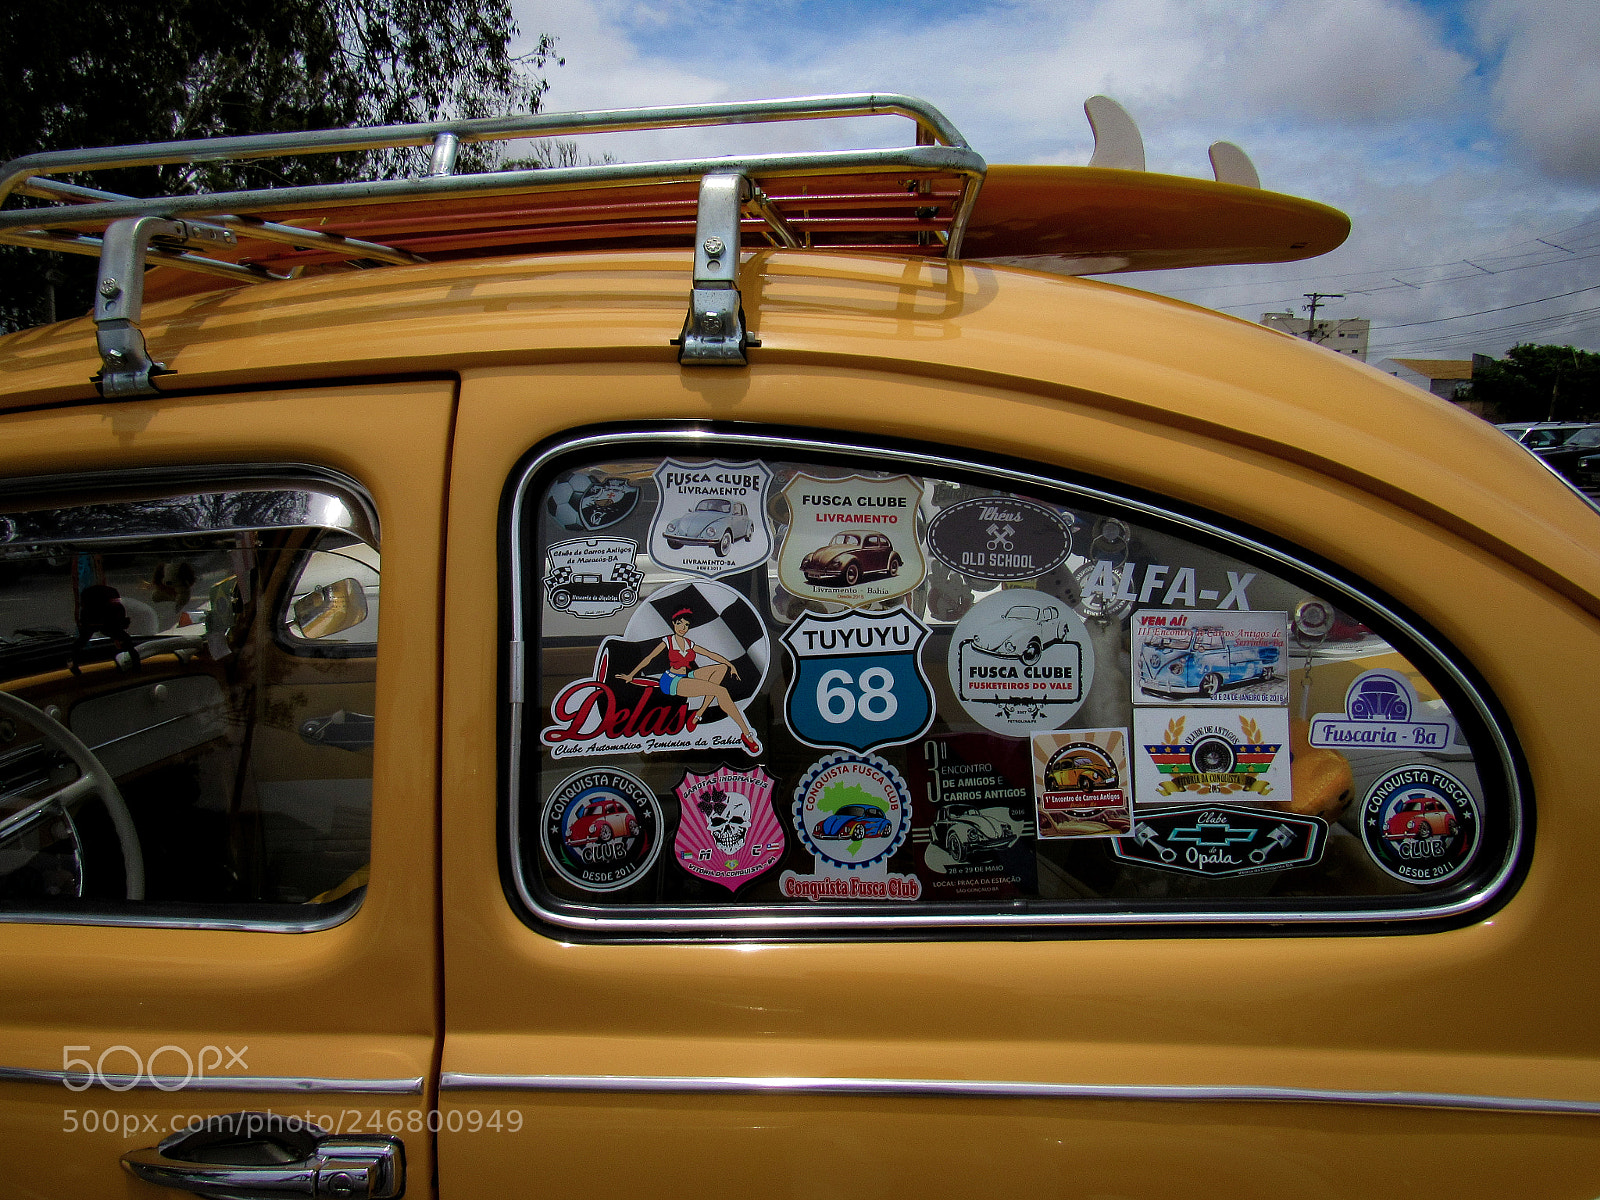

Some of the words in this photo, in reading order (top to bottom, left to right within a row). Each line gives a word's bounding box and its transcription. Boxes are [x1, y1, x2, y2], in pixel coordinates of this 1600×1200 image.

[666, 472, 712, 489] FUSCA
[715, 473, 760, 492] CLUBE
[678, 486, 747, 496] LIVRAMENTO
[802, 494, 853, 506] FUSCA
[857, 496, 907, 508] CLUBE
[816, 513, 898, 524] LIVRAMENTO
[962, 551, 985, 566] OLD
[989, 553, 1036, 569] SCHOOL
[812, 585, 858, 594] Livramento
[867, 587, 889, 595] Bahia
[1080, 560, 1256, 611] ALFA-X
[1140, 616, 1167, 626] VEM
[802, 625, 910, 650] TUYUYU
[1152, 627, 1193, 637] Encontro
[1235, 629, 1270, 640] Antigos
[1271, 628, 1281, 638] de
[969, 666, 1019, 679] FUSCA
[1023, 666, 1072, 679] CLUBE
[816, 666, 898, 724] 68
[1032, 682, 1047, 690] DO
[1050, 682, 1073, 690] VALE
[544, 681, 689, 742] Delas
[1322, 724, 1397, 743] Fuscaria
[1412, 726, 1437, 745] Ba
[554, 744, 583, 756] Clube
[587, 741, 642, 753] Automotivo
[645, 739, 692, 751] Feminino
[694, 737, 708, 747] da
[711, 735, 743, 746] Bahia
[941, 763, 992, 775] ENCONTRO
[805, 765, 850, 811] CONQUISTA
[852, 765, 885, 785] FUSCA
[884, 784, 899, 811] CLUB
[942, 779, 956, 789] DE
[957, 776, 996, 787] AMIGOS
[997, 776, 1004, 785] E
[551, 774, 609, 820] CONQUISTA
[612, 776, 648, 807] FUSCA
[943, 791, 982, 802] CARROS
[984, 788, 1027, 799] ANTIGOS
[1051, 795, 1074, 803] Encontro
[1075, 794, 1082, 802] de
[1368, 771, 1429, 813] CONQUISTA
[1431, 774, 1468, 807] FUSCA
[1197, 812, 1228, 824] Clube
[582, 842, 627, 864] CLUB
[1185, 847, 1243, 869] Opala
[1398, 839, 1445, 860] CLUB
[582, 870, 614, 881] DESDE
[615, 862, 637, 879] 2011
[1398, 865, 1431, 878] DESDE
[1432, 861, 1455, 877] 2011
[785, 877, 849, 900] Conquista
[849, 877, 886, 897] Fusca
[887, 877, 919, 897] Club
